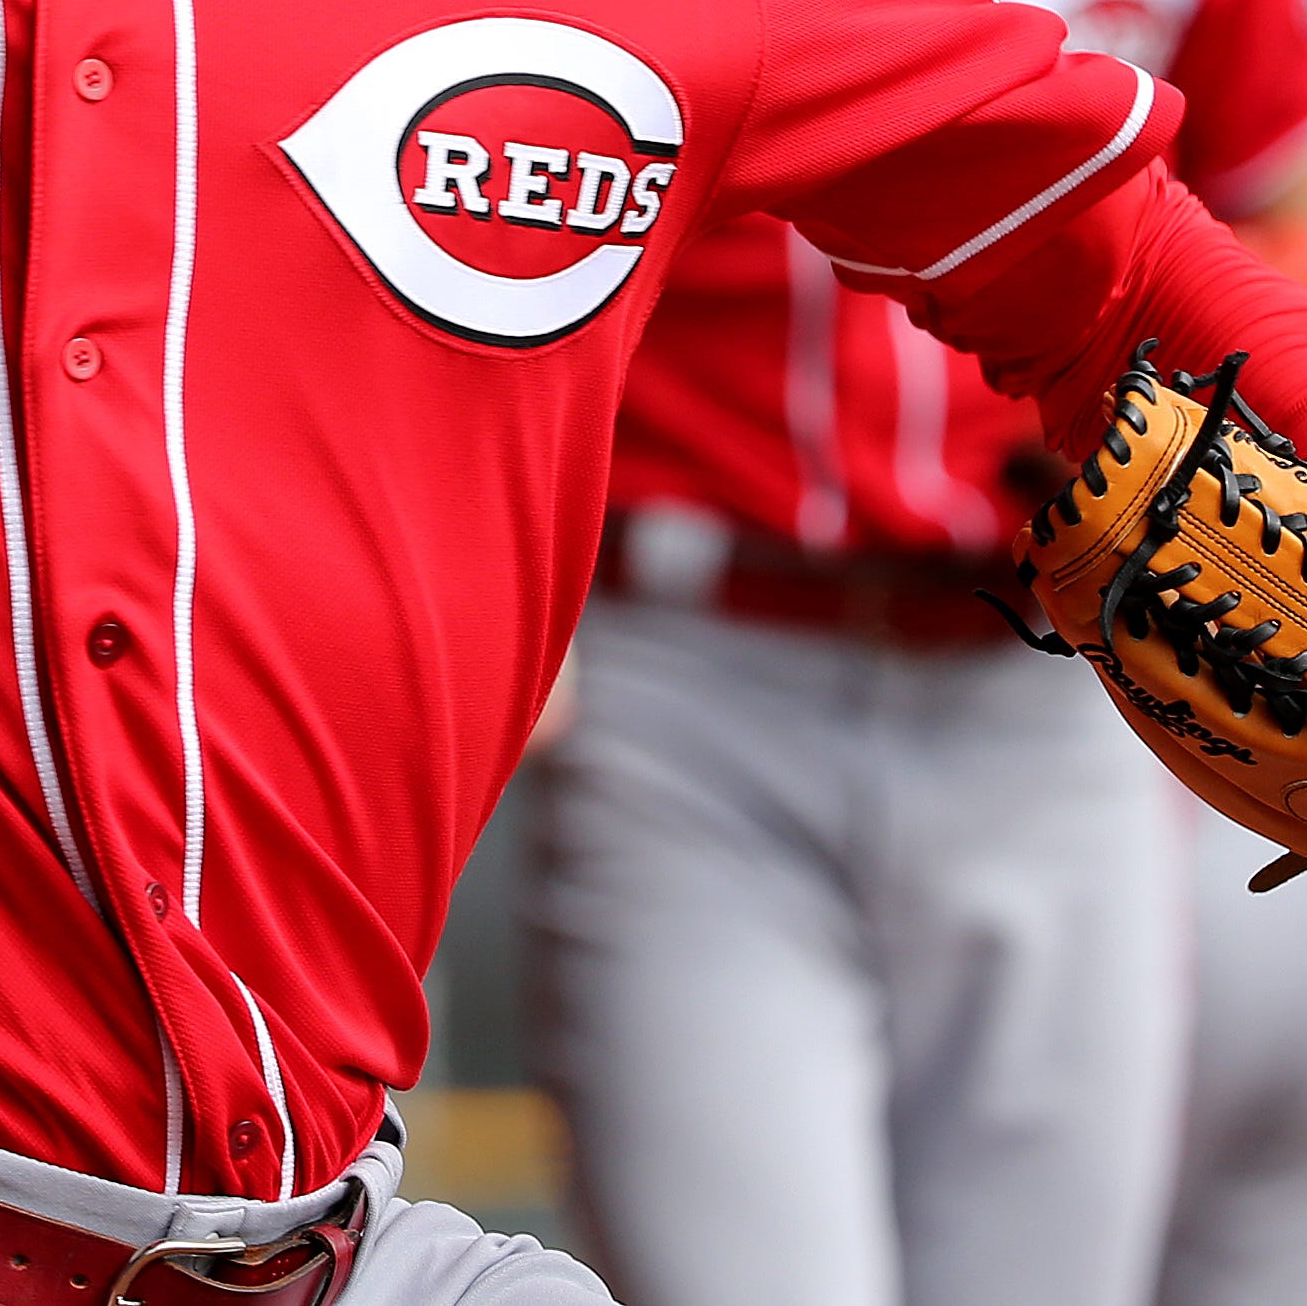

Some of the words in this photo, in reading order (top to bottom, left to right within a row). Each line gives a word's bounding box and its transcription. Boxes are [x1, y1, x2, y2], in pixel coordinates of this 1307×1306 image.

[277, 16, 684, 348] C
[411, 130, 678, 240] REDS
[1077, 643, 1258, 765] Rawlings
